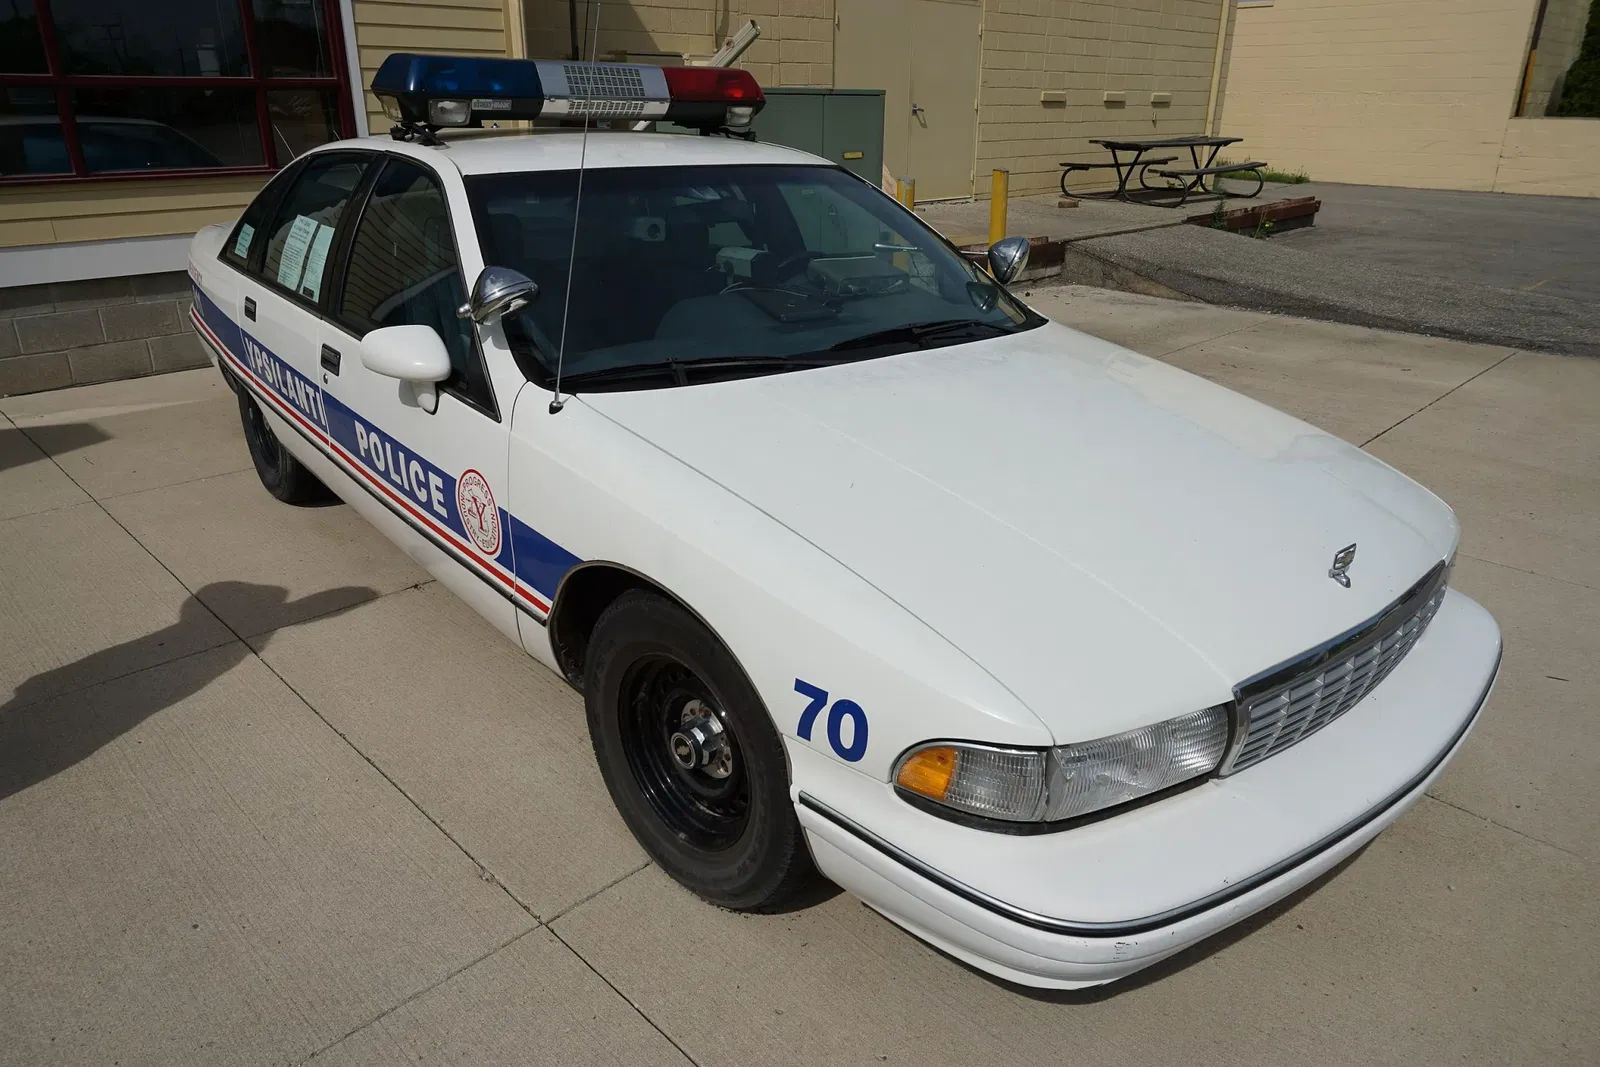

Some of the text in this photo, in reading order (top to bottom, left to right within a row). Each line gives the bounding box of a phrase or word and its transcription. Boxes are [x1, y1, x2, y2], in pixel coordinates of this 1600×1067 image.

[244, 337, 448, 519] YPSILANTI POLICE
[462, 476, 493, 507] PROGRESS
[472, 495, 487, 532] Y
[793, 677, 869, 762] 70
